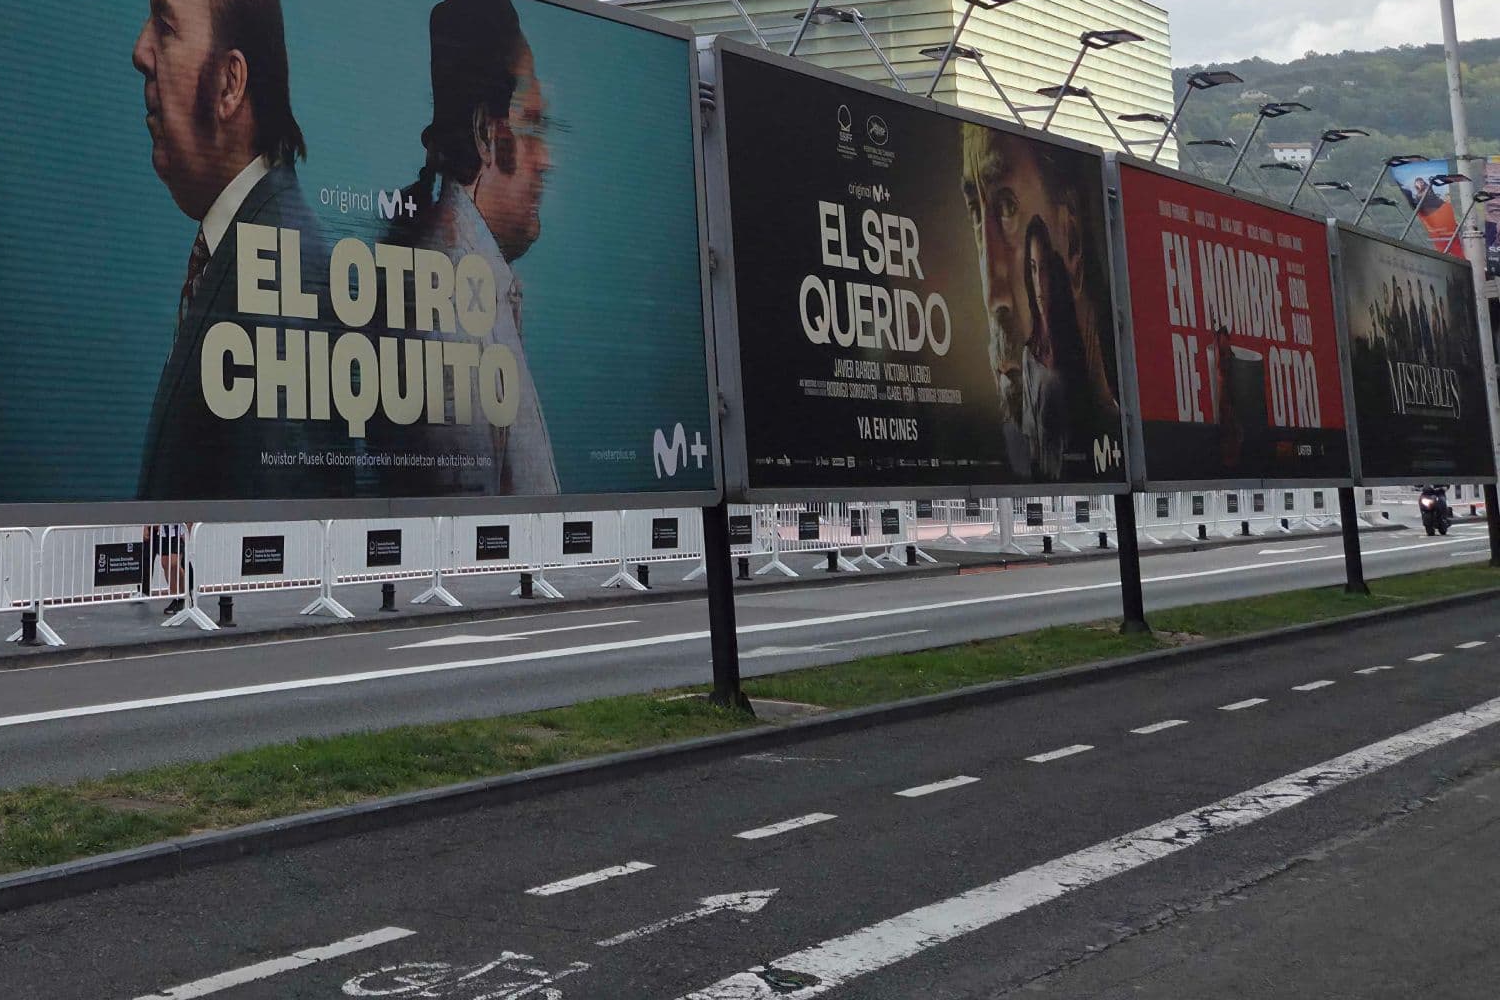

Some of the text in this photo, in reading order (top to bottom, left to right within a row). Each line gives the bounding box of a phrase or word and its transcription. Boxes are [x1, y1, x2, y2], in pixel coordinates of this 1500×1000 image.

[319, 185, 373, 214] original
[818, 200, 924, 280] EL SER
[236, 221, 497, 337] EL OTRO
[799, 273, 952, 356] QUERIDO
[1161, 231, 1287, 342] EN NOMBRE
[201, 321, 521, 439] CHIQUITO
[1171, 333, 1205, 423] DE
[1268, 345, 1322, 429] OTRO
[260, 451, 297, 465] Movistar
[299, 452, 325, 465] Plusek
[857, 416, 918, 441] YA EN CINES
